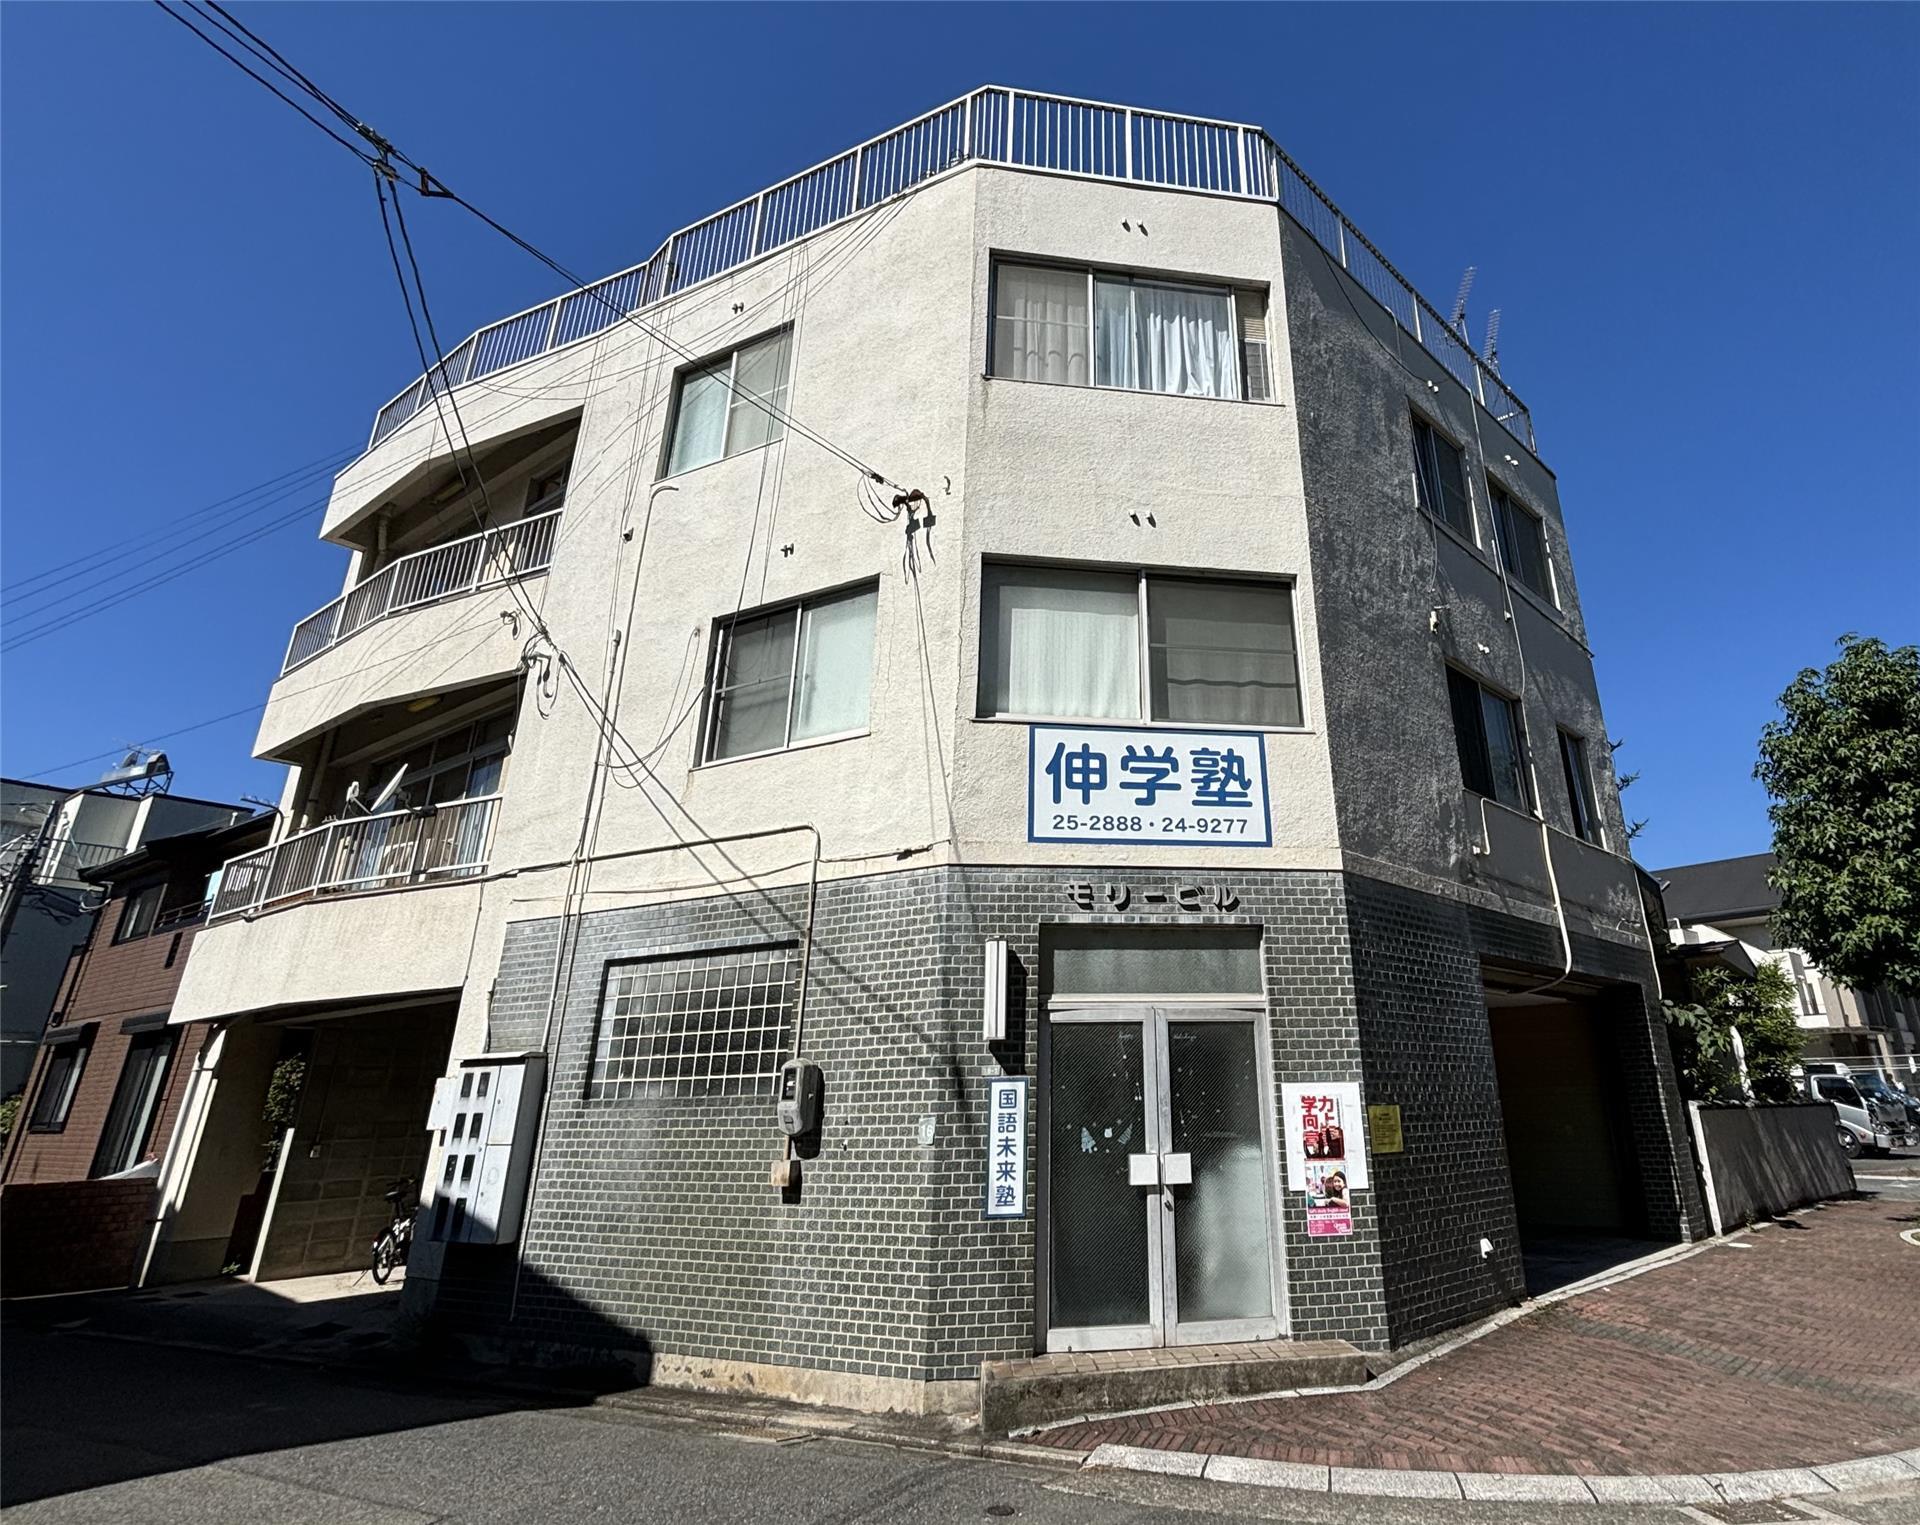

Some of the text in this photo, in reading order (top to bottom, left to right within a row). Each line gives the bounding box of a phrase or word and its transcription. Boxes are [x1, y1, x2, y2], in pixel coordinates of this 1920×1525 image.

[1045, 742, 1253, 808] 伸学塾
[1067, 880, 1238, 909] モリービル
[921, 1124, 934, 1137] 16
[995, 1089, 1017, 1208] 国語未来塾
